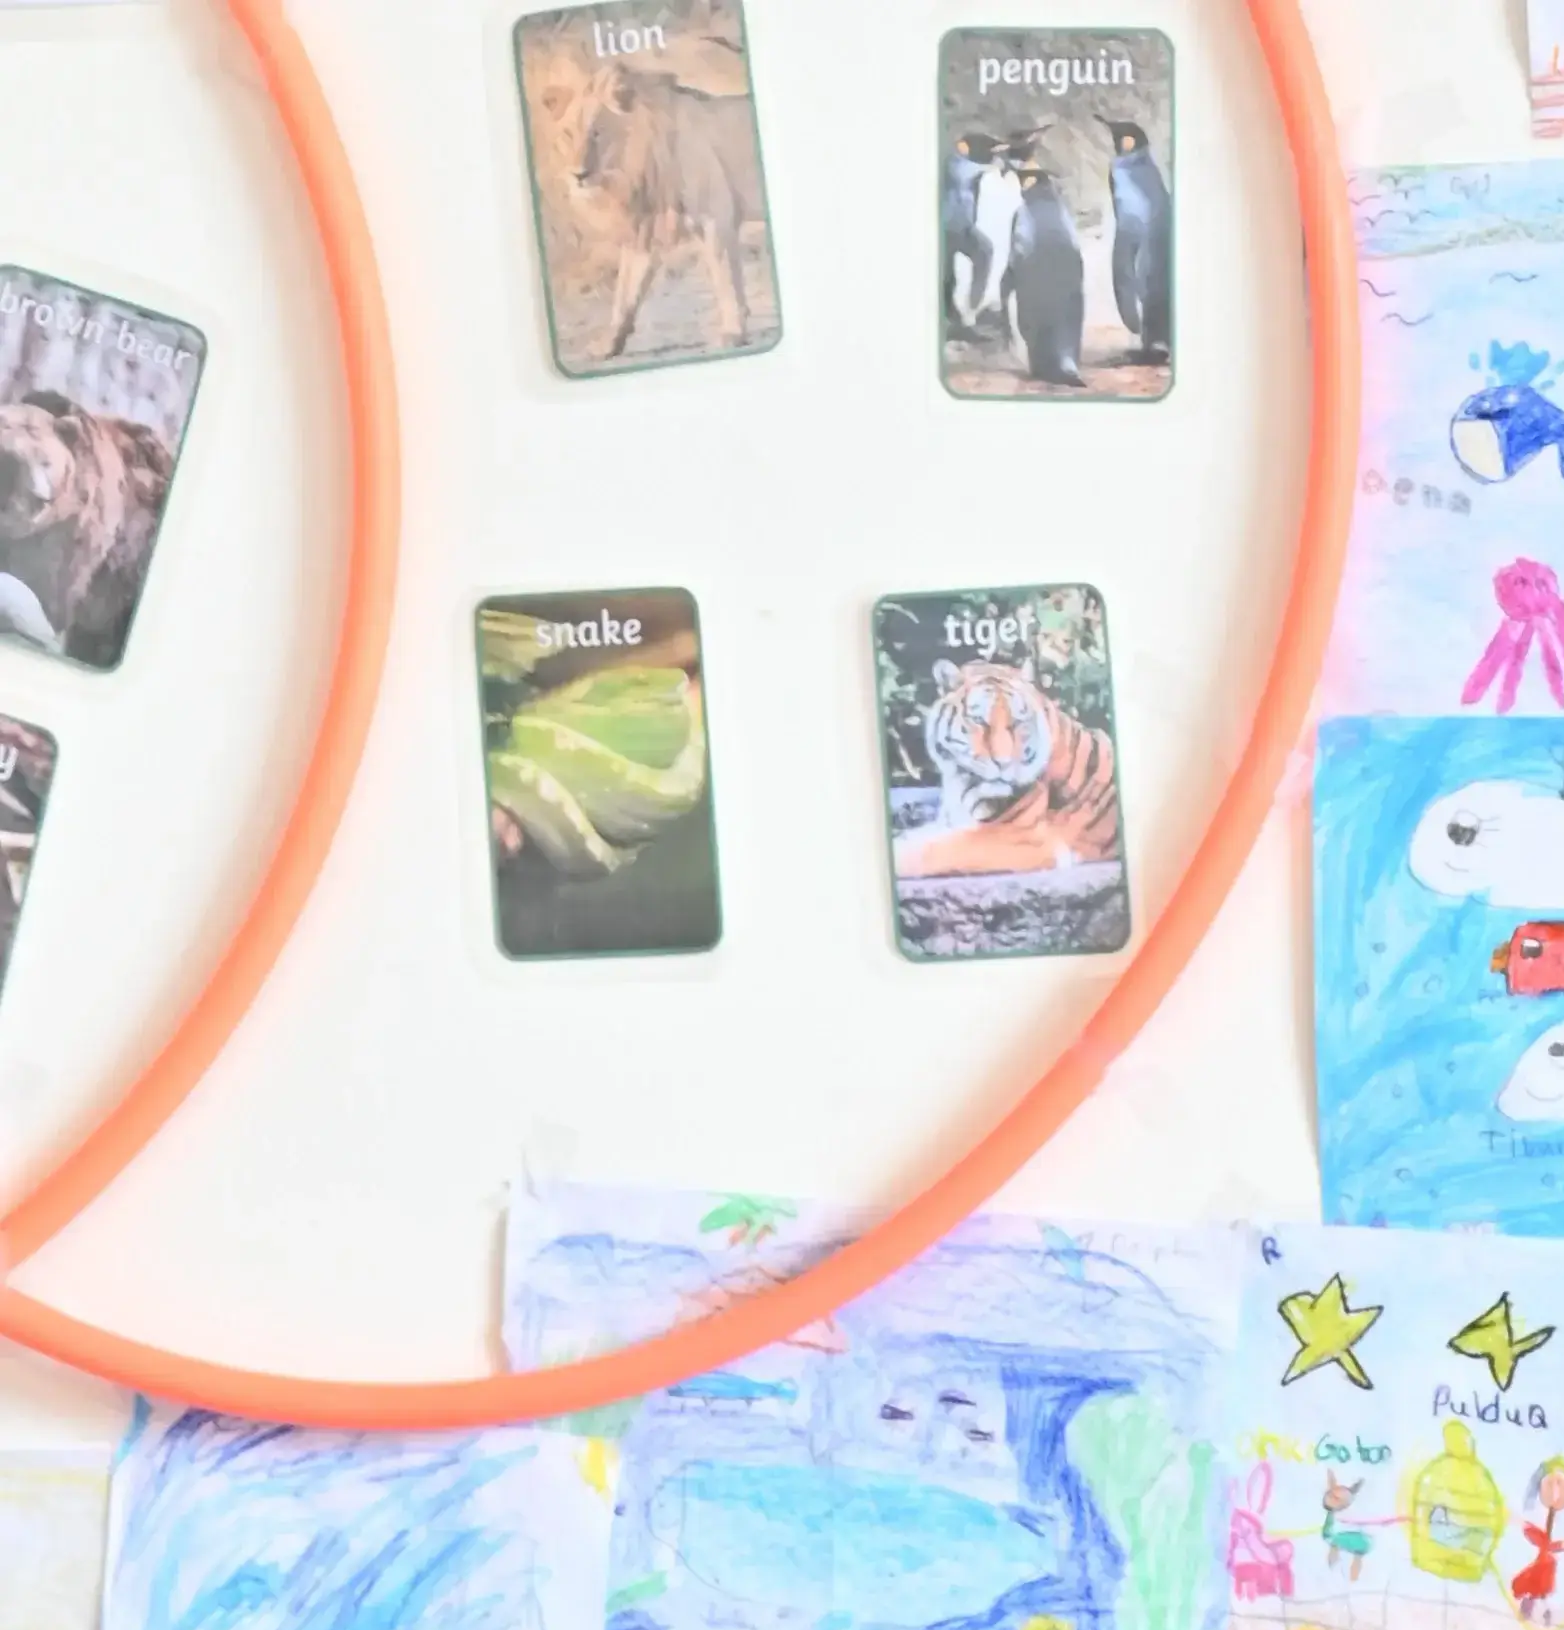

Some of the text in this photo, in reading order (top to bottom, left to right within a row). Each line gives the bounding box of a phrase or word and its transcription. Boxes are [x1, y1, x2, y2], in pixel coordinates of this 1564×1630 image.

[593, 19, 667, 58] lion
[978, 52, 1135, 96] penguin
[0, 280, 192, 372] brown bear
[535, 608, 643, 650] snake
[943, 605, 1038, 659] tiger
